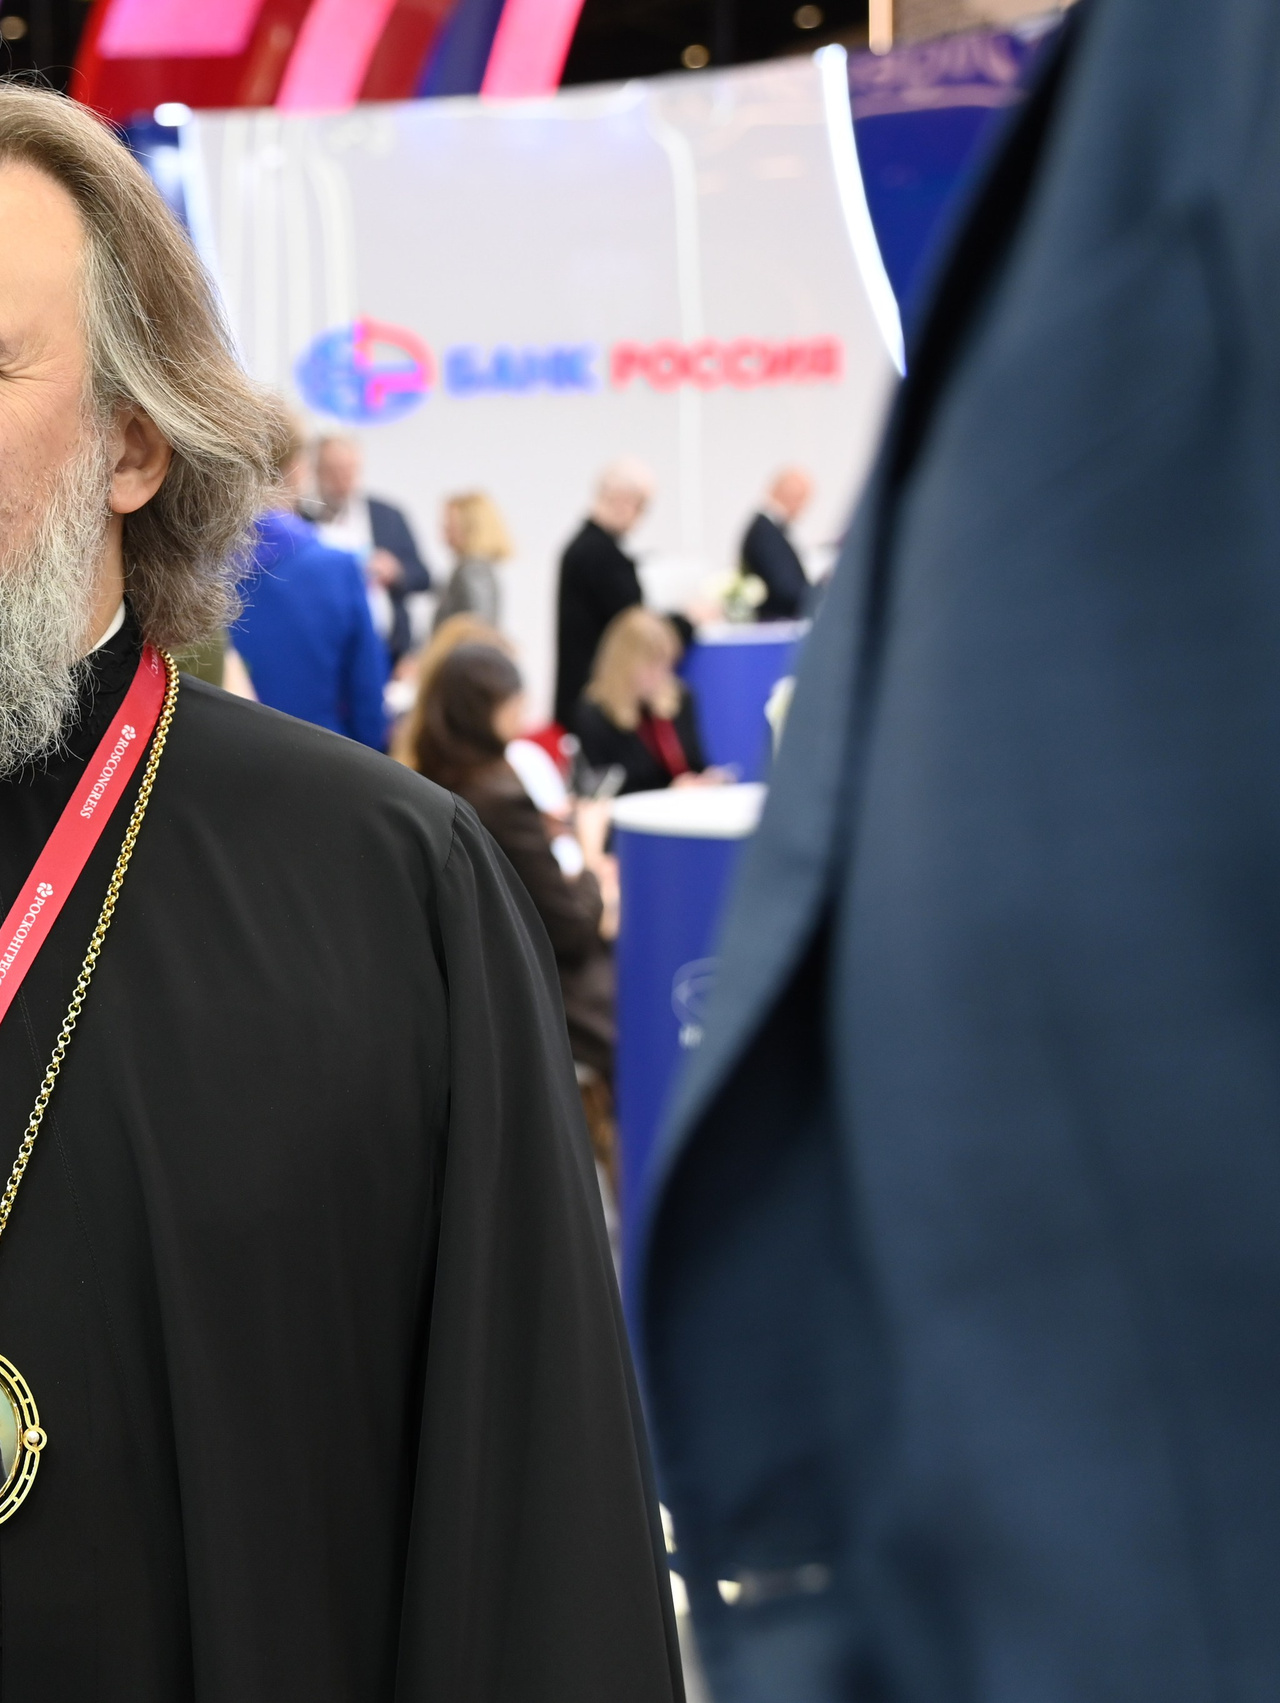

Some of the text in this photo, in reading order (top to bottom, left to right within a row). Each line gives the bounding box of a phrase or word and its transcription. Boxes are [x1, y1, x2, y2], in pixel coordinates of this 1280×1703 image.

[444, 335, 843, 396] БАНК РОССИЯ
[80, 737, 129, 820] ROSCONGRESS
